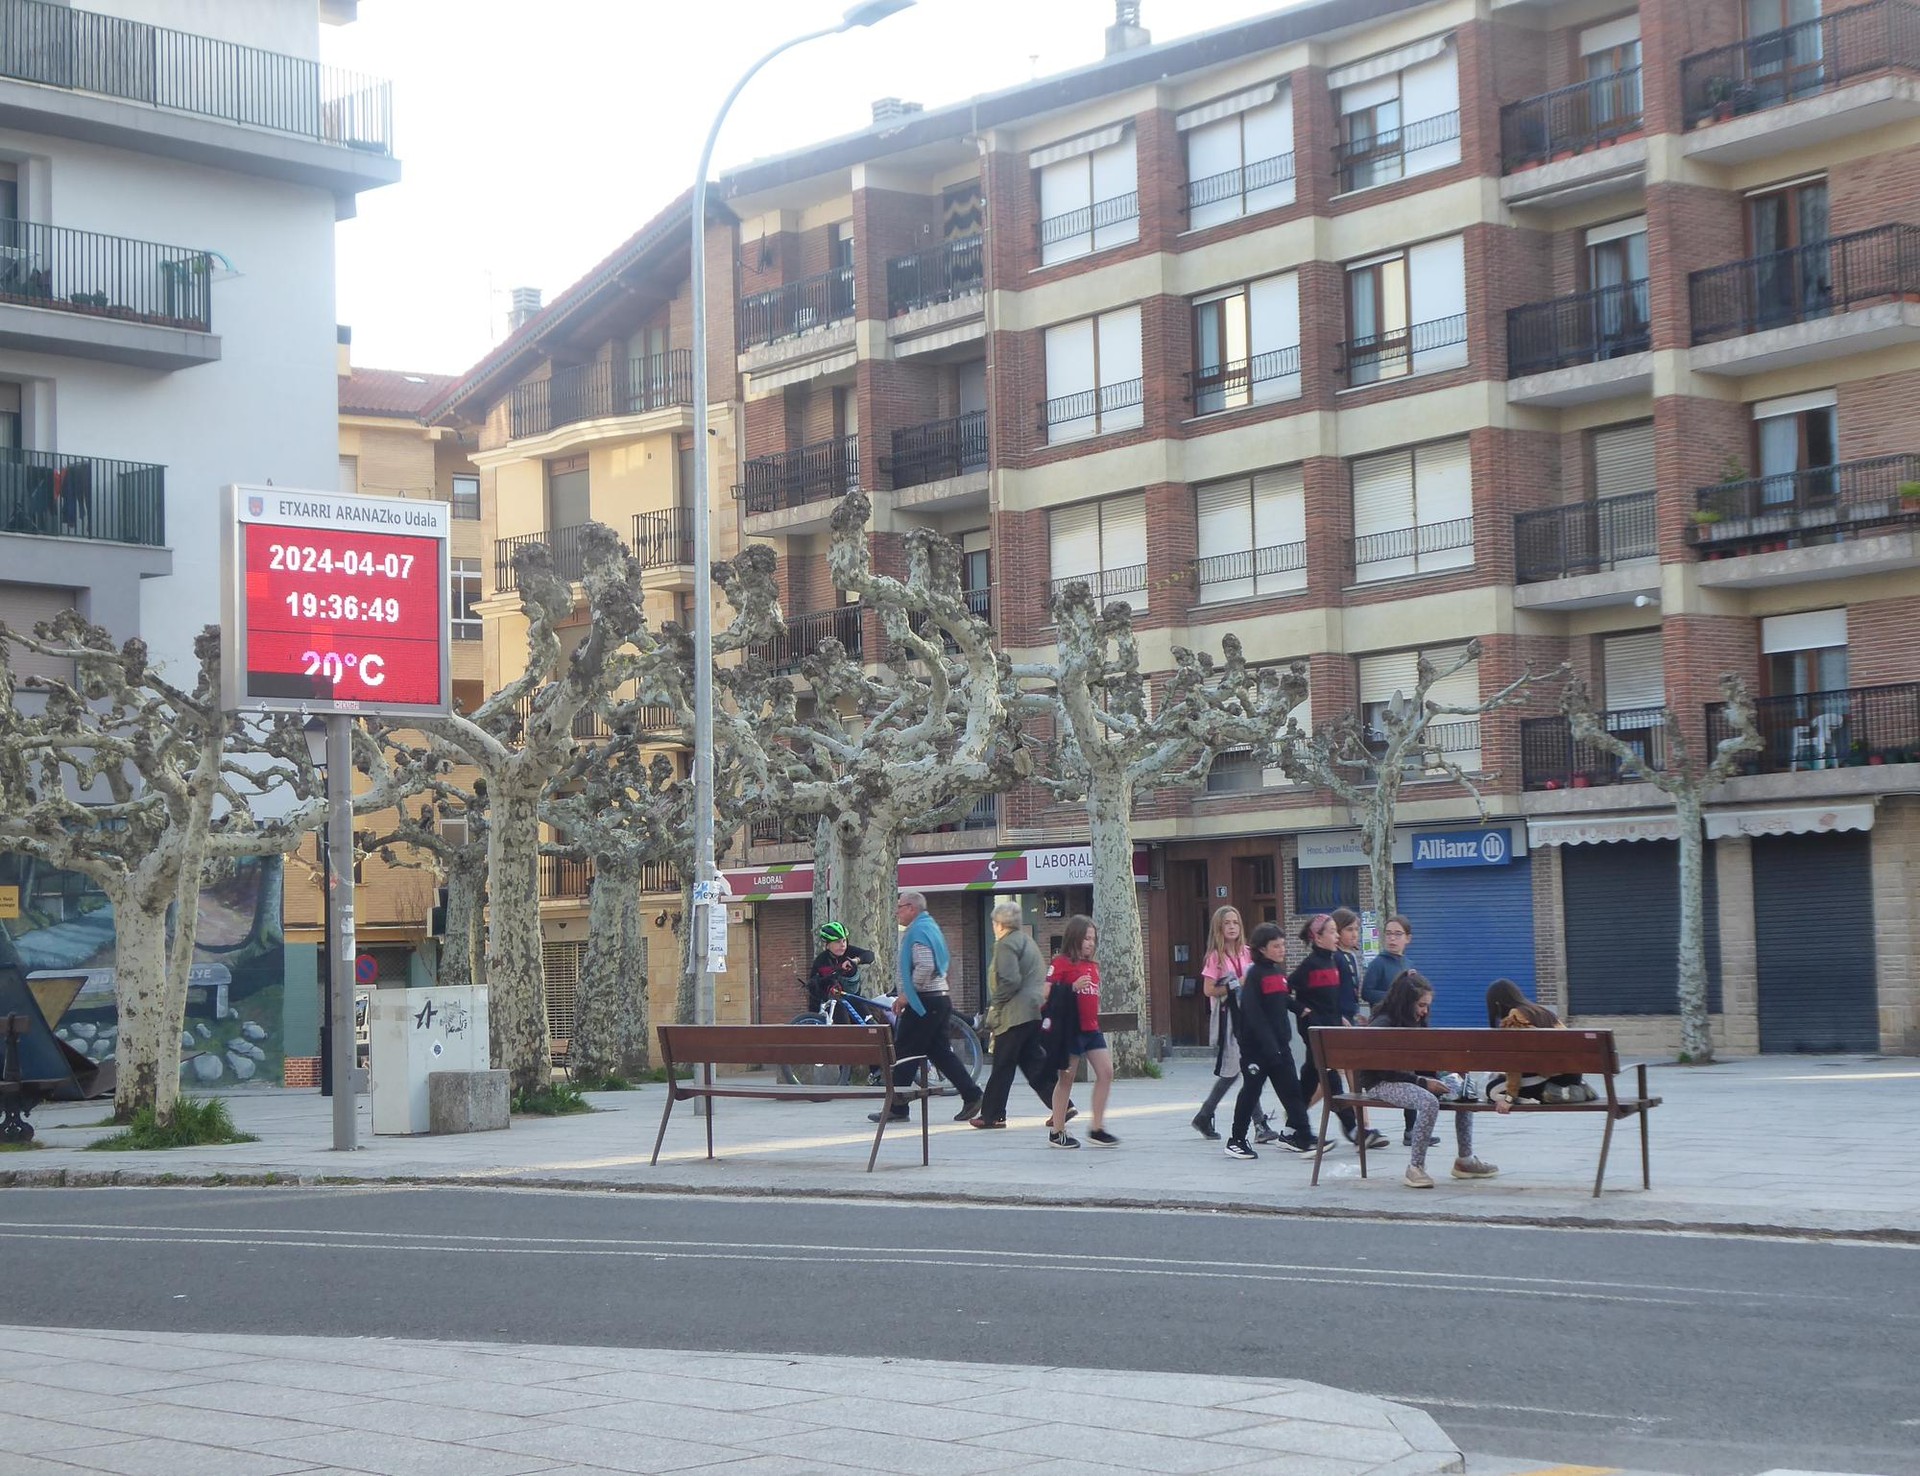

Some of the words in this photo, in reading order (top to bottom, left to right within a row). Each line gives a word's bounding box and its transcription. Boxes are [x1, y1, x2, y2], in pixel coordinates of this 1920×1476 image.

[279, 500, 331, 519] ETXARRI
[335, 505, 402, 524] ARANAZko
[404, 510, 437, 527] Udala
[269, 544, 414, 579] 2024-04-07
[286, 591, 399, 623] 19:36:49
[1035, 853, 1093, 869] LABORAL
[1417, 839, 1478, 861] Allianz
[753, 875, 784, 886] LABORAL
[1069, 869, 1094, 879] kutxa
